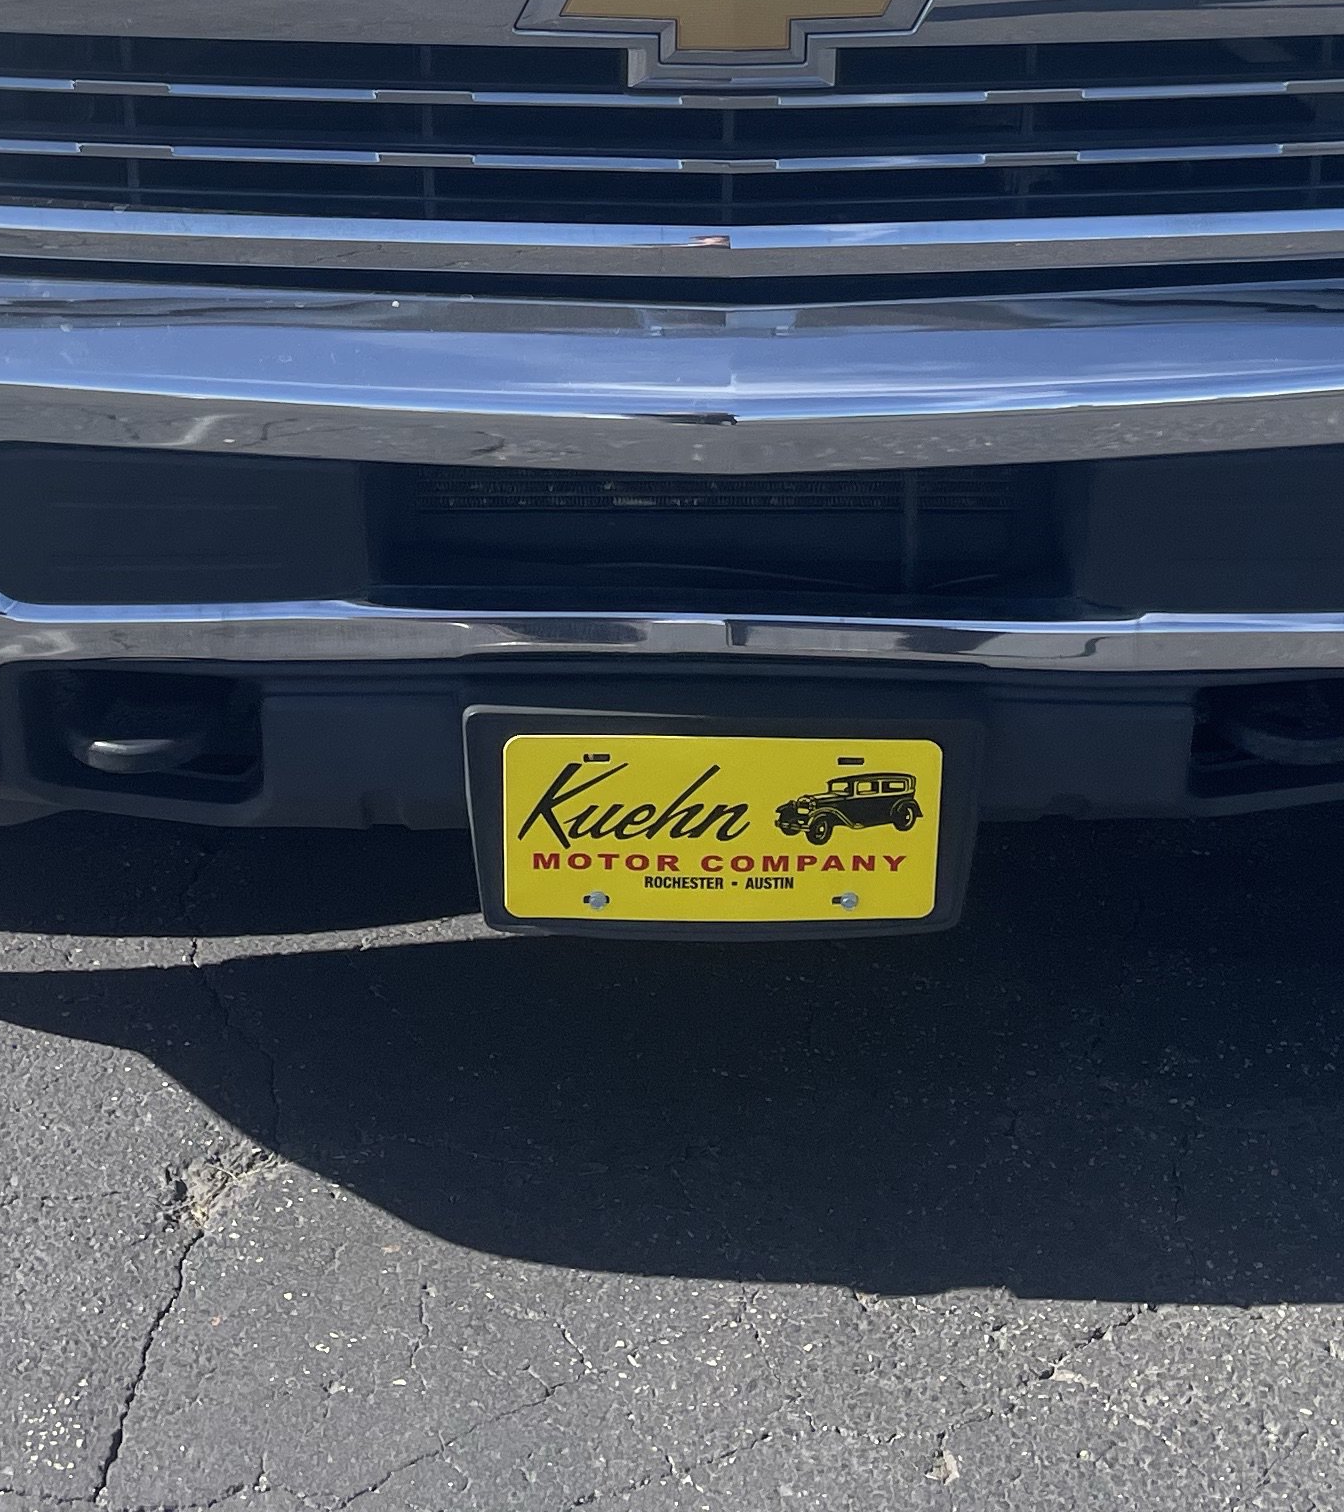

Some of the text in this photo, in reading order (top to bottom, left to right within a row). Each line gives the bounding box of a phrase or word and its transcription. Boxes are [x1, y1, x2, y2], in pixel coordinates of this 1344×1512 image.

[517, 761, 751, 850] Kuehn
[532, 851, 908, 874] MOTOR COMPANY
[643, 874, 725, 891] ROCHESTER
[744, 875, 795, 891] AUSTIN
